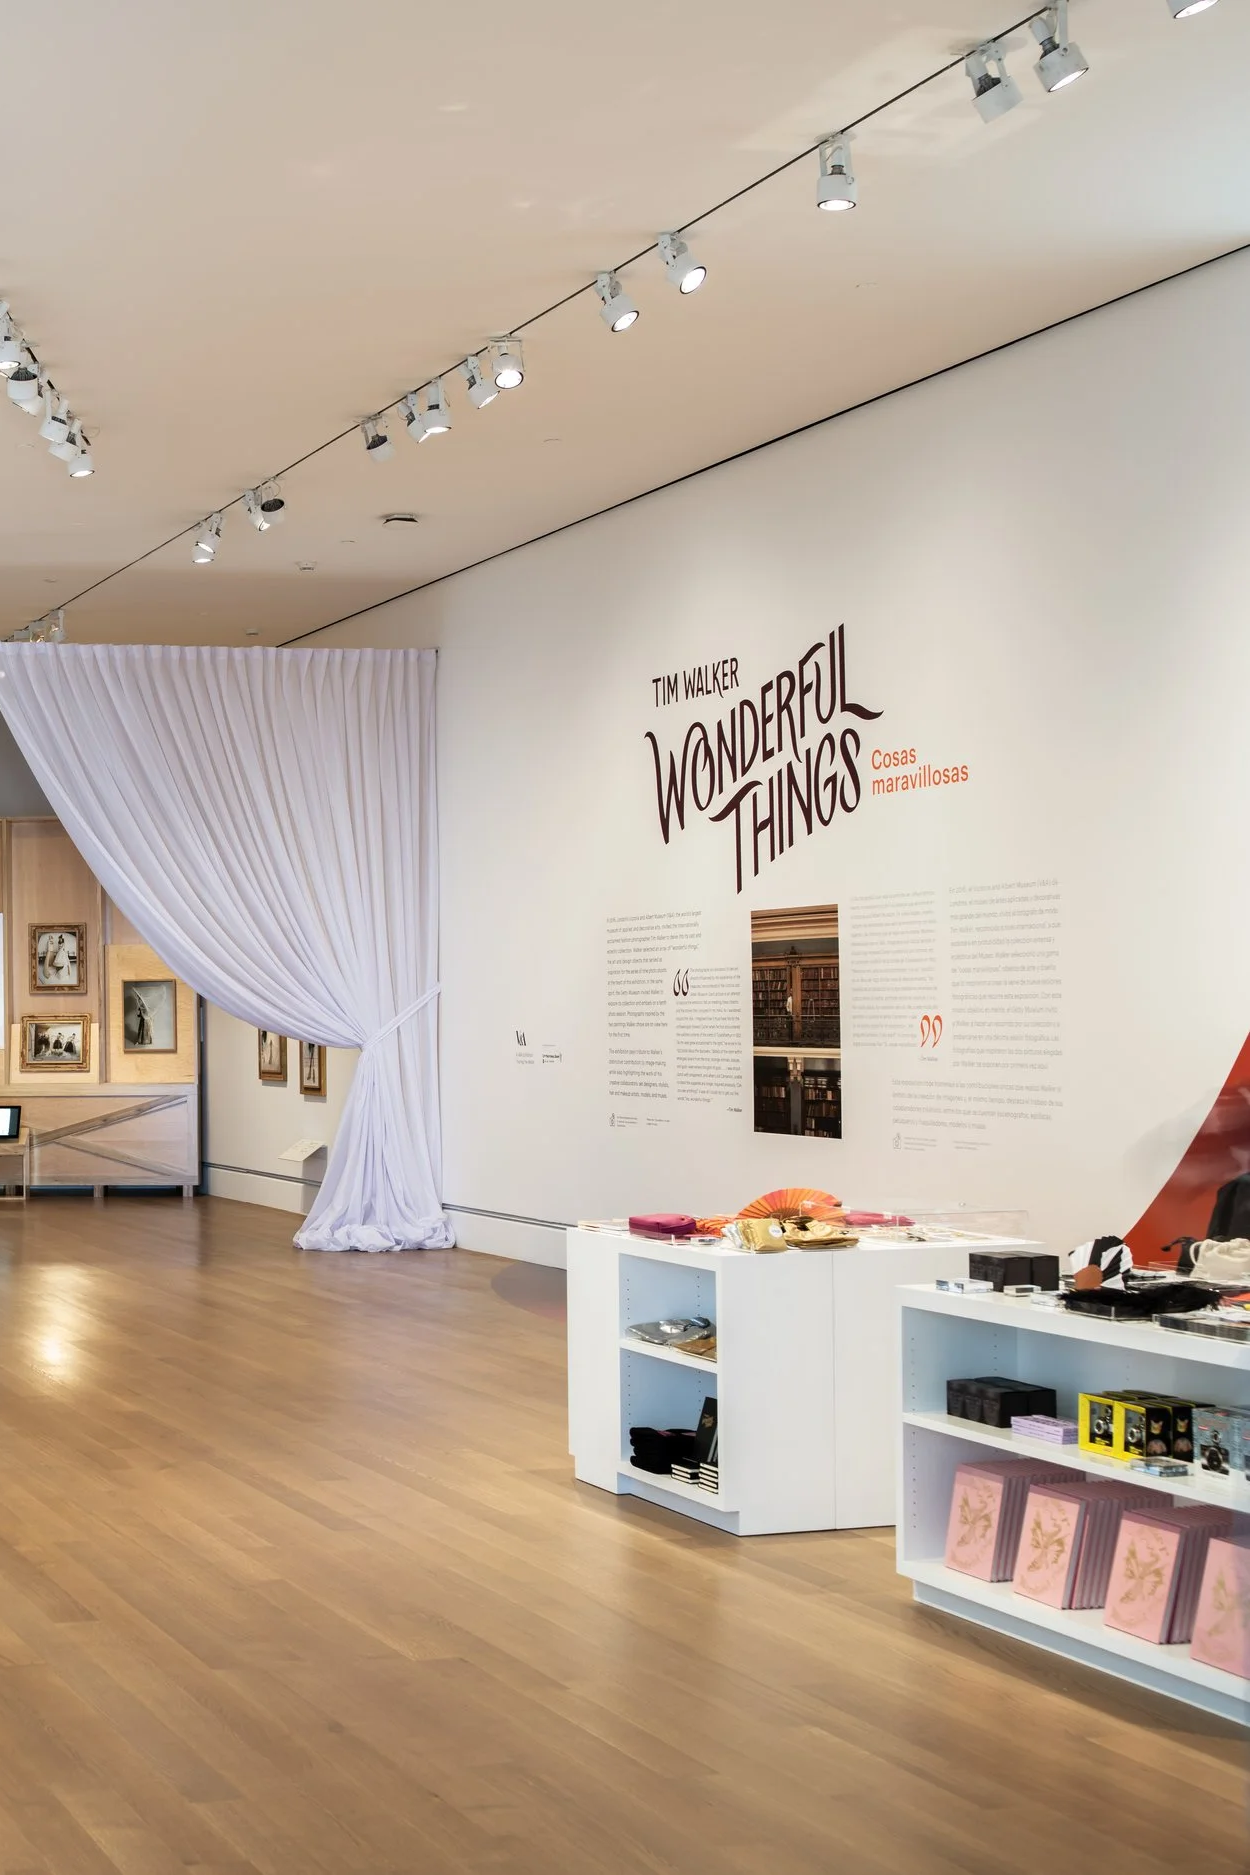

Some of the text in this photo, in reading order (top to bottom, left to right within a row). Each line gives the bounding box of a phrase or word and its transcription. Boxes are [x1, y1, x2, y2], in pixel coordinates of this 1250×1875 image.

[652, 657, 740, 707] TIM WALKER
[644, 622, 884, 845] WONDERFUL
[871, 747, 917, 771] Cosas
[872, 763, 969, 796] maravillosas
[708, 728, 861, 894] THINGS
